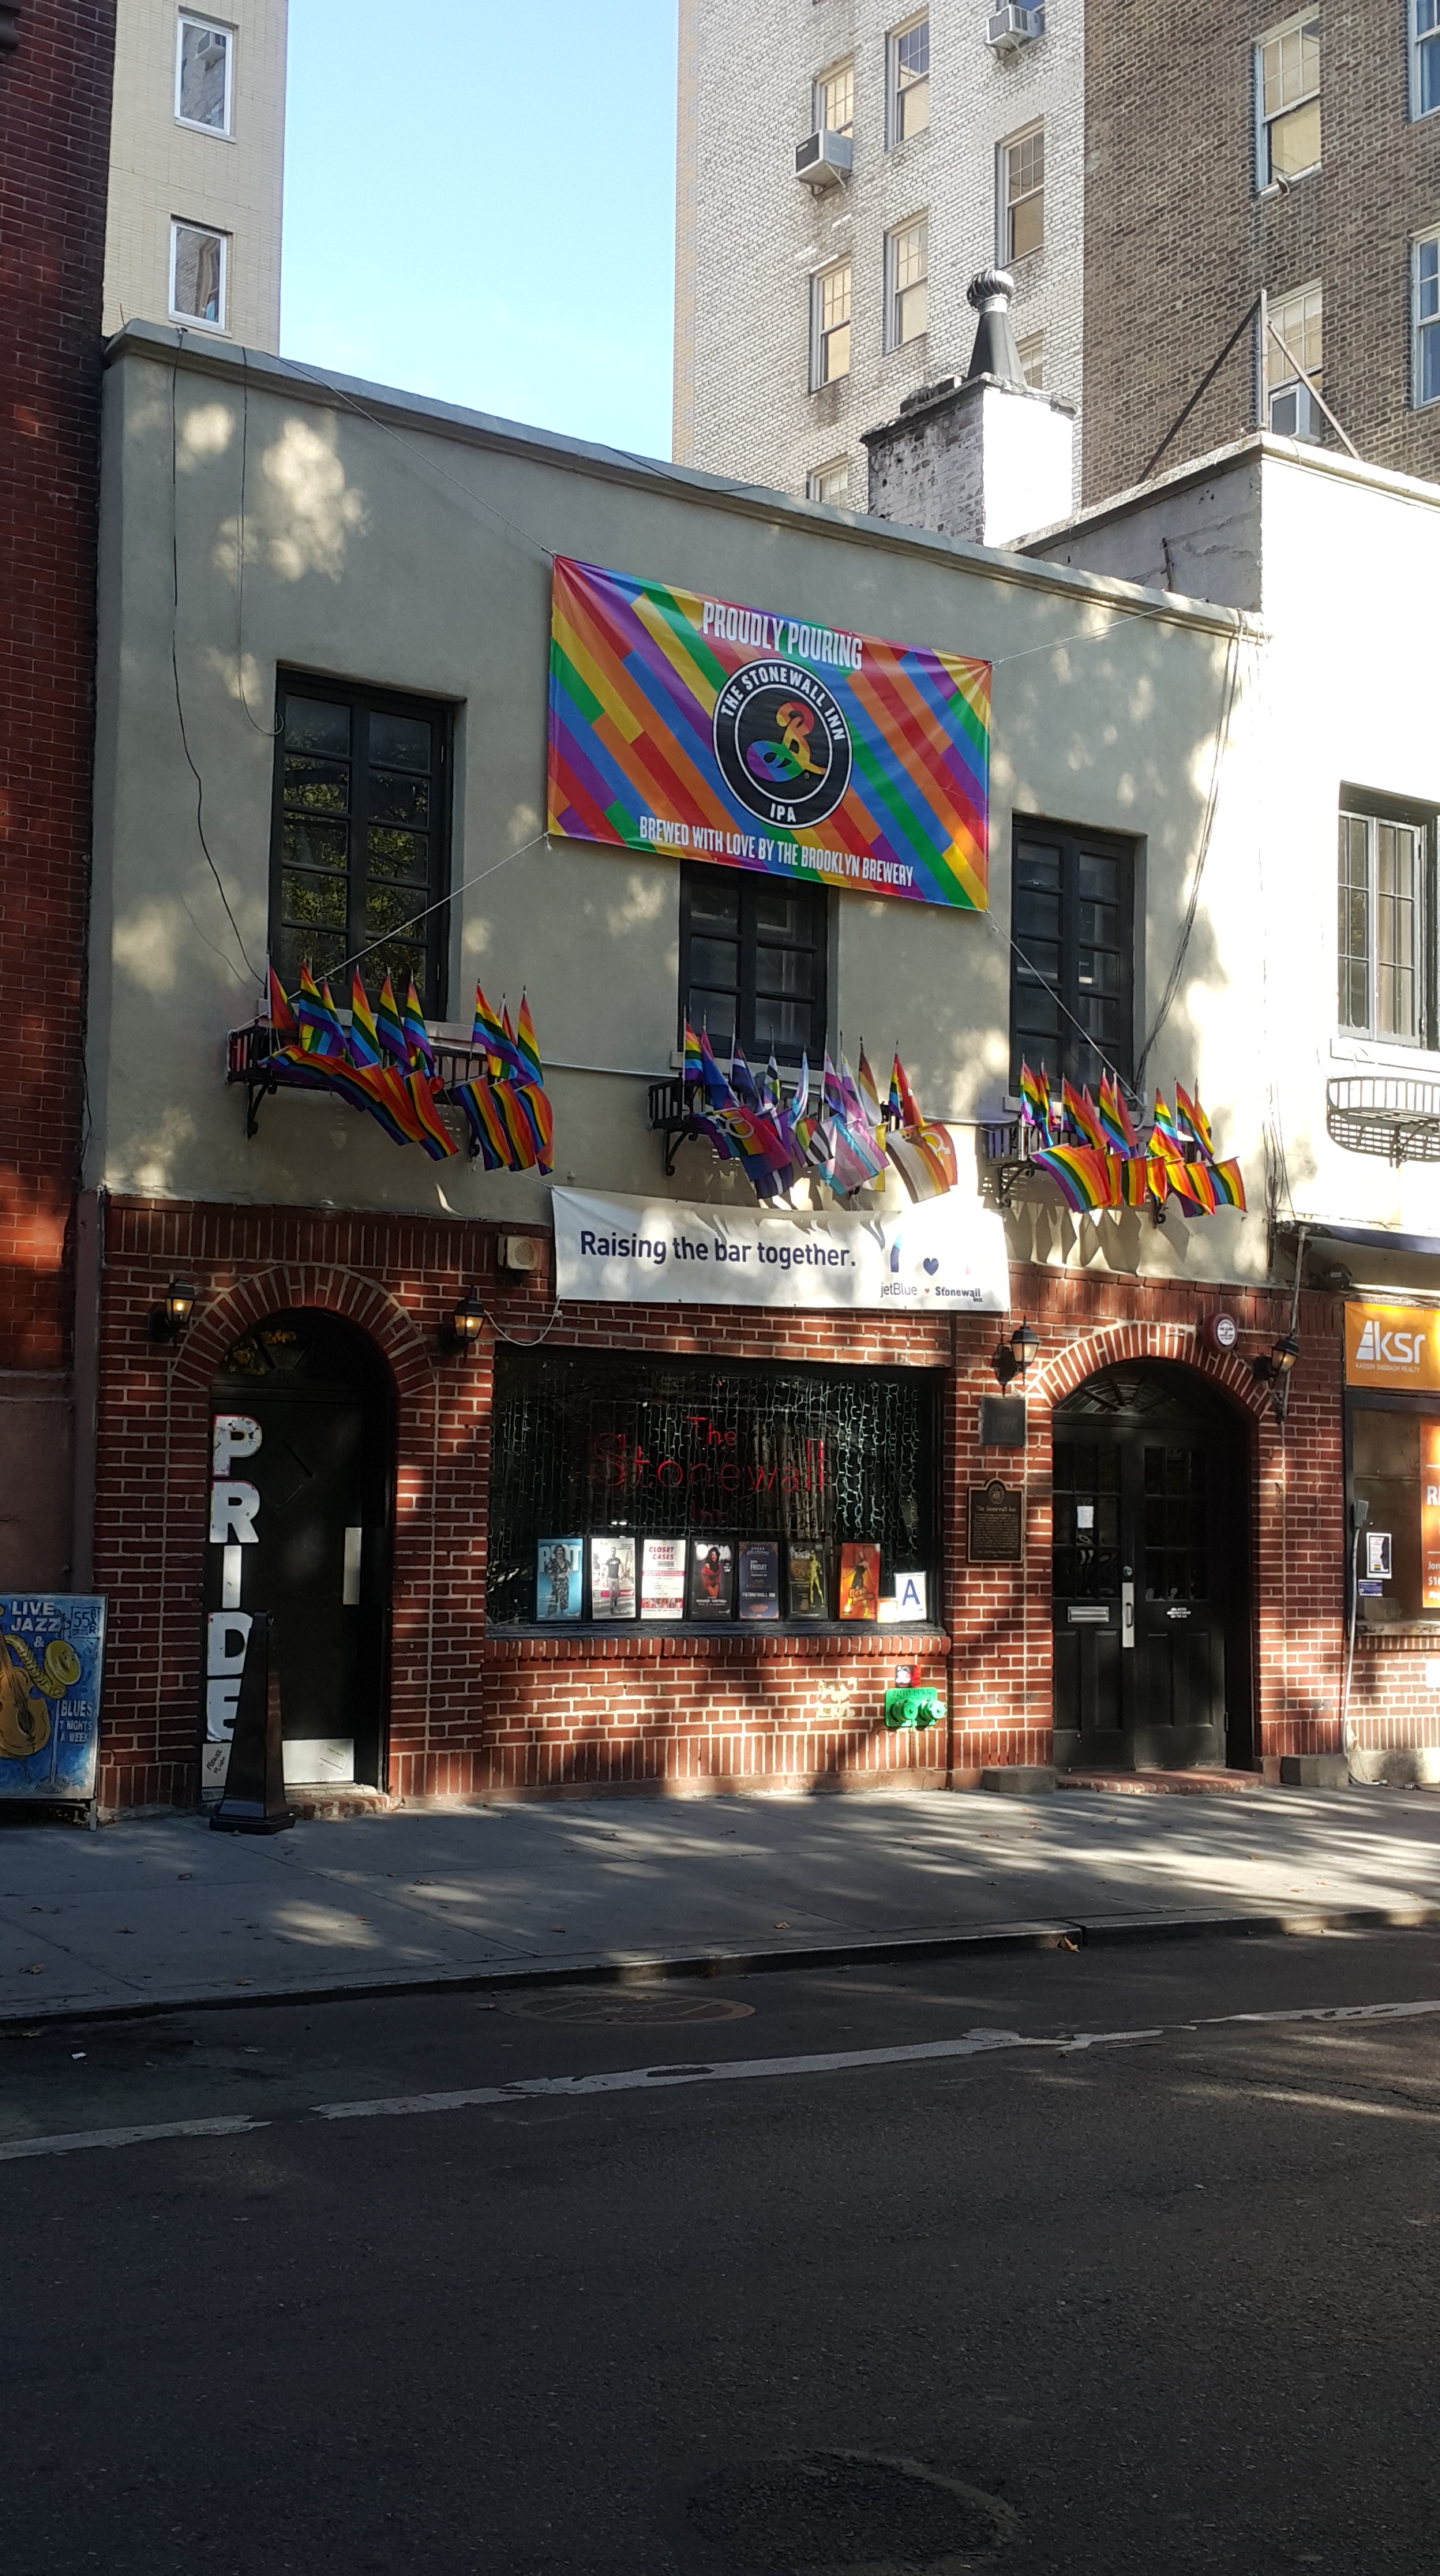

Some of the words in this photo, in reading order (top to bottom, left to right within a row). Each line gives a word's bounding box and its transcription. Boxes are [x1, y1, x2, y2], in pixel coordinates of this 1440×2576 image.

[703, 601, 784, 652] PROUDLY
[787, 622, 863, 670] POURING
[721, 685, 744, 717] THE
[741, 666, 826, 708] STONEWALL
[825, 706, 846, 741] INN
[770, 803, 797, 822] IPA
[639, 815, 689, 846] BREWED
[692, 826, 723, 853] WITH
[726, 833, 756, 859] LOVE
[758, 837, 774, 861] BY
[777, 841, 799, 866] THE
[801, 845, 860, 877] BROOKLYN
[862, 857, 914, 887] BREWERY
[580, 1230, 666, 1264] Raising
[673, 1236, 708, 1260] the
[714, 1237, 752, 1263] bar
[756, 1241, 856, 1270] together.
[880, 1282, 917, 1297] jetBlue
[935, 1286, 981, 1297] Stonewall
[1374, 1320, 1426, 1364] ksr
[684, 1417, 737, 1447] The
[594, 1433, 824, 1494] Stonewall
[691, 1500, 729, 1523] Inn
[206, 1414, 262, 1742] PRIDE
[902, 1578, 921, 1606] A
[12, 1601, 55, 1616] LIVE
[74, 1611, 91, 1628] 55
[10, 1617, 62, 1632] JAZZ
[88, 1608, 97, 1634] BAR
[33, 1636, 45, 1648] &
[61, 1699, 93, 1717] BLUES
[59, 1720, 64, 1730] 7
[66, 1720, 92, 1731] NIGHTS
[60, 1732, 66, 1742] A
[69, 1732, 89, 1743] WEEK
